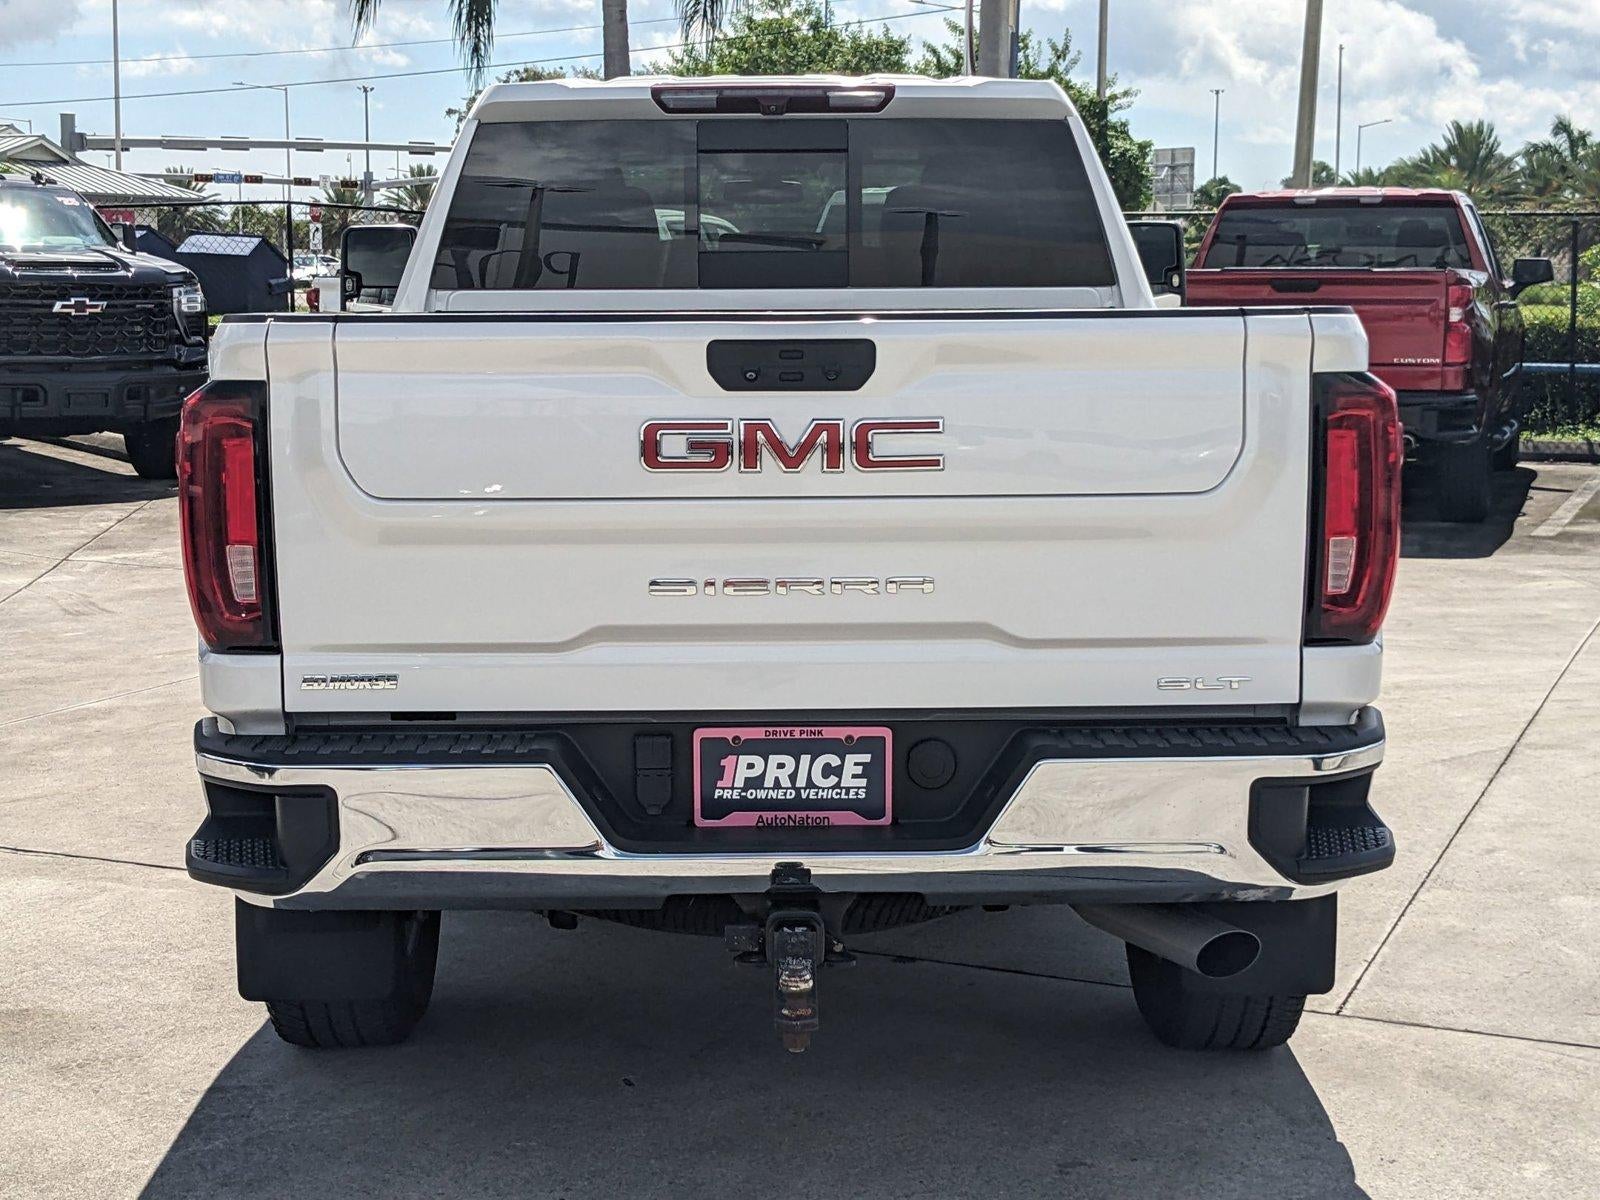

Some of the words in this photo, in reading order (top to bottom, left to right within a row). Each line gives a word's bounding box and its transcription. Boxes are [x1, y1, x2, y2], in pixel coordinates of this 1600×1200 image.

[640, 417, 945, 473] GMC
[649, 576, 935, 596] SIERRA
[1157, 676, 1252, 690] SLT
[764, 729, 796, 738] DRIVE
[799, 729, 824, 737] PINK
[714, 788, 796, 799] PRE-OWNED
[801, 788, 866, 799] VEHICLES
[755, 814, 831, 828] AutoNation
